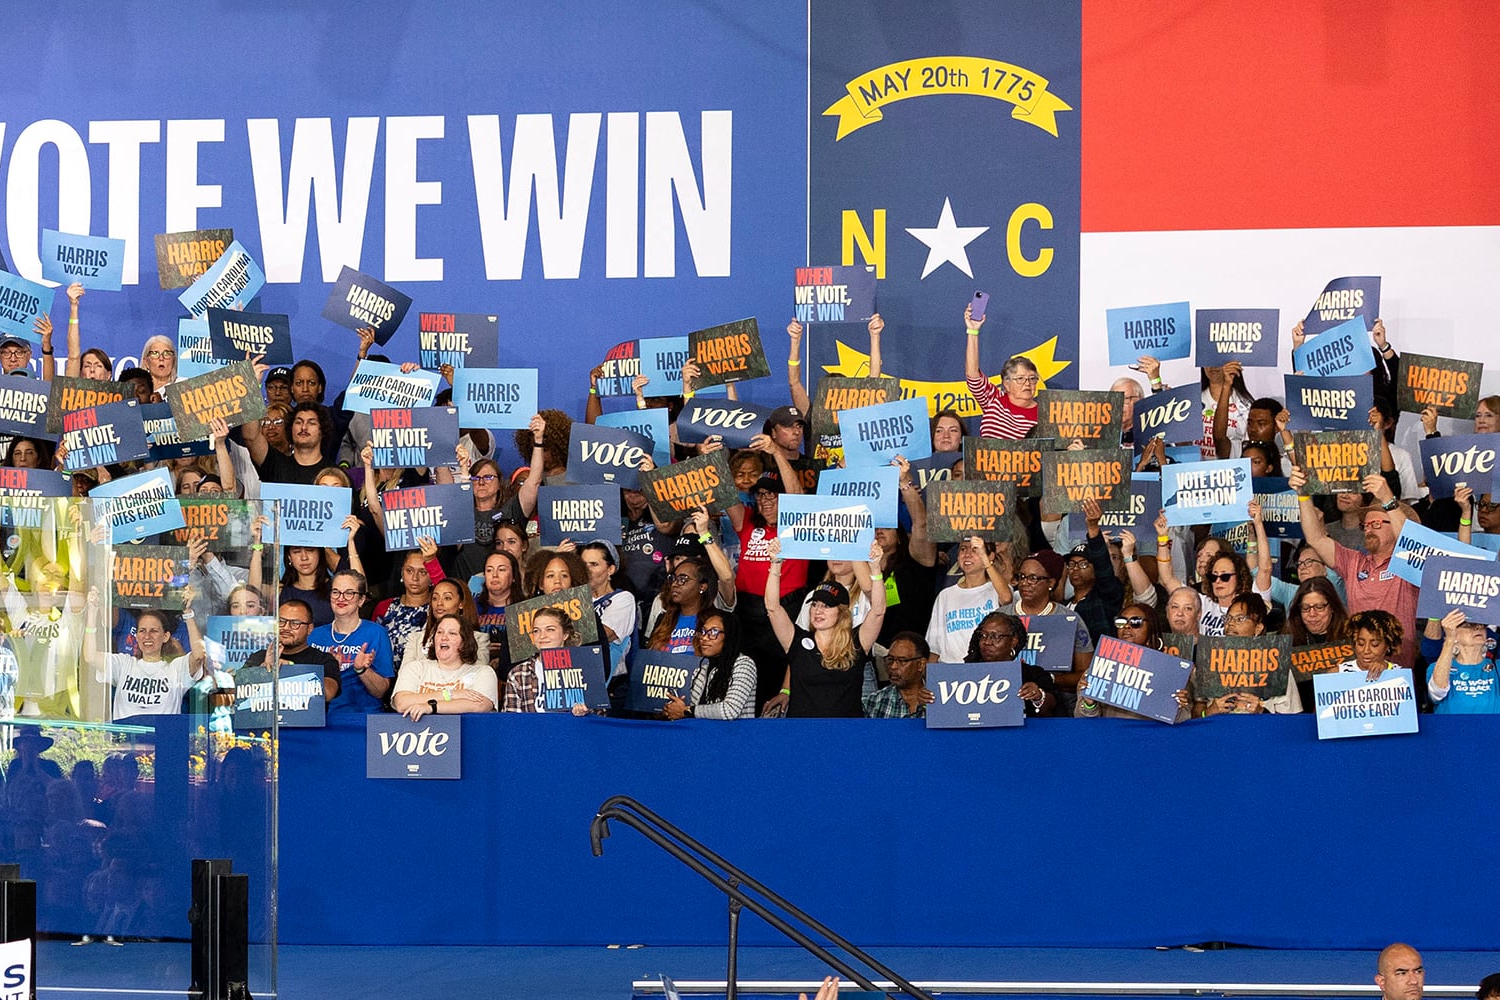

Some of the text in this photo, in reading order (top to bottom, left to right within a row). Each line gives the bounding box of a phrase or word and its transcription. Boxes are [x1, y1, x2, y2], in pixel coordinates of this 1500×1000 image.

[859, 65, 1034, 106] MAY 20th 1775
[248, 116, 444, 282] WE
[469, 111, 731, 279] WIN
[841, 203, 1054, 279] N C
[57, 245, 108, 268] HARRIS
[63, 263, 99, 278] WALZ
[795, 267, 833, 286] WHEN
[794, 284, 852, 306] WE VOTE,
[794, 303, 845, 322] WE WIN
[1124, 317, 1176, 339] HARRIS
[1209, 322, 1262, 342] HARRIS
[696, 332, 751, 358] HARRIS
[1133, 336, 1169, 350] WALZ
[1216, 341, 1253, 354] WALZ
[707, 359, 748, 376] WALZ
[1407, 365, 1469, 394] HARRIS
[466, 383, 520, 403] HARRIS
[933, 392, 977, 413] 12th
[1301, 388, 1356, 409] HARRIS
[1413, 389, 1455, 408] WALZ
[63, 408, 97, 431] WHEN
[371, 409, 412, 428] WHEN
[475, 402, 512, 415] WALZ
[691, 407, 758, 430] vote
[1139, 397, 1193, 433] vote
[1310, 407, 1348, 420] WALZ
[64, 424, 121, 452] WE VOTE,
[372, 428, 433, 450] WE VOTE,
[859, 415, 914, 442] HARRIS
[579, 439, 643, 470] vote
[869, 435, 909, 453] WALZ
[64, 445, 117, 470] WE WIN
[372, 447, 426, 468] WE WIN
[1429, 447, 1496, 477] vote
[1176, 468, 1236, 491] VOTE FOR
[940, 492, 1005, 516] HARRIS
[1176, 487, 1236, 509] FREEDOM
[551, 500, 604, 520] HARRIS
[779, 511, 873, 529] NORTH CAROLINA
[560, 519, 596, 533] WALZ
[950, 516, 995, 531] WALZ
[792, 527, 860, 544] VOTES EARLY
[1098, 637, 1144, 667] WHEN
[1210, 646, 1279, 673] HARRIS
[1091, 656, 1154, 696] WE VOTE,
[1220, 672, 1268, 688] WALZ
[937, 675, 1010, 706] vote
[1084, 675, 1143, 710] WE WIN
[1317, 686, 1413, 706] NORTH CAROLINA
[1332, 701, 1400, 720] VOTES EARLY
[378, 726, 449, 756] vote
